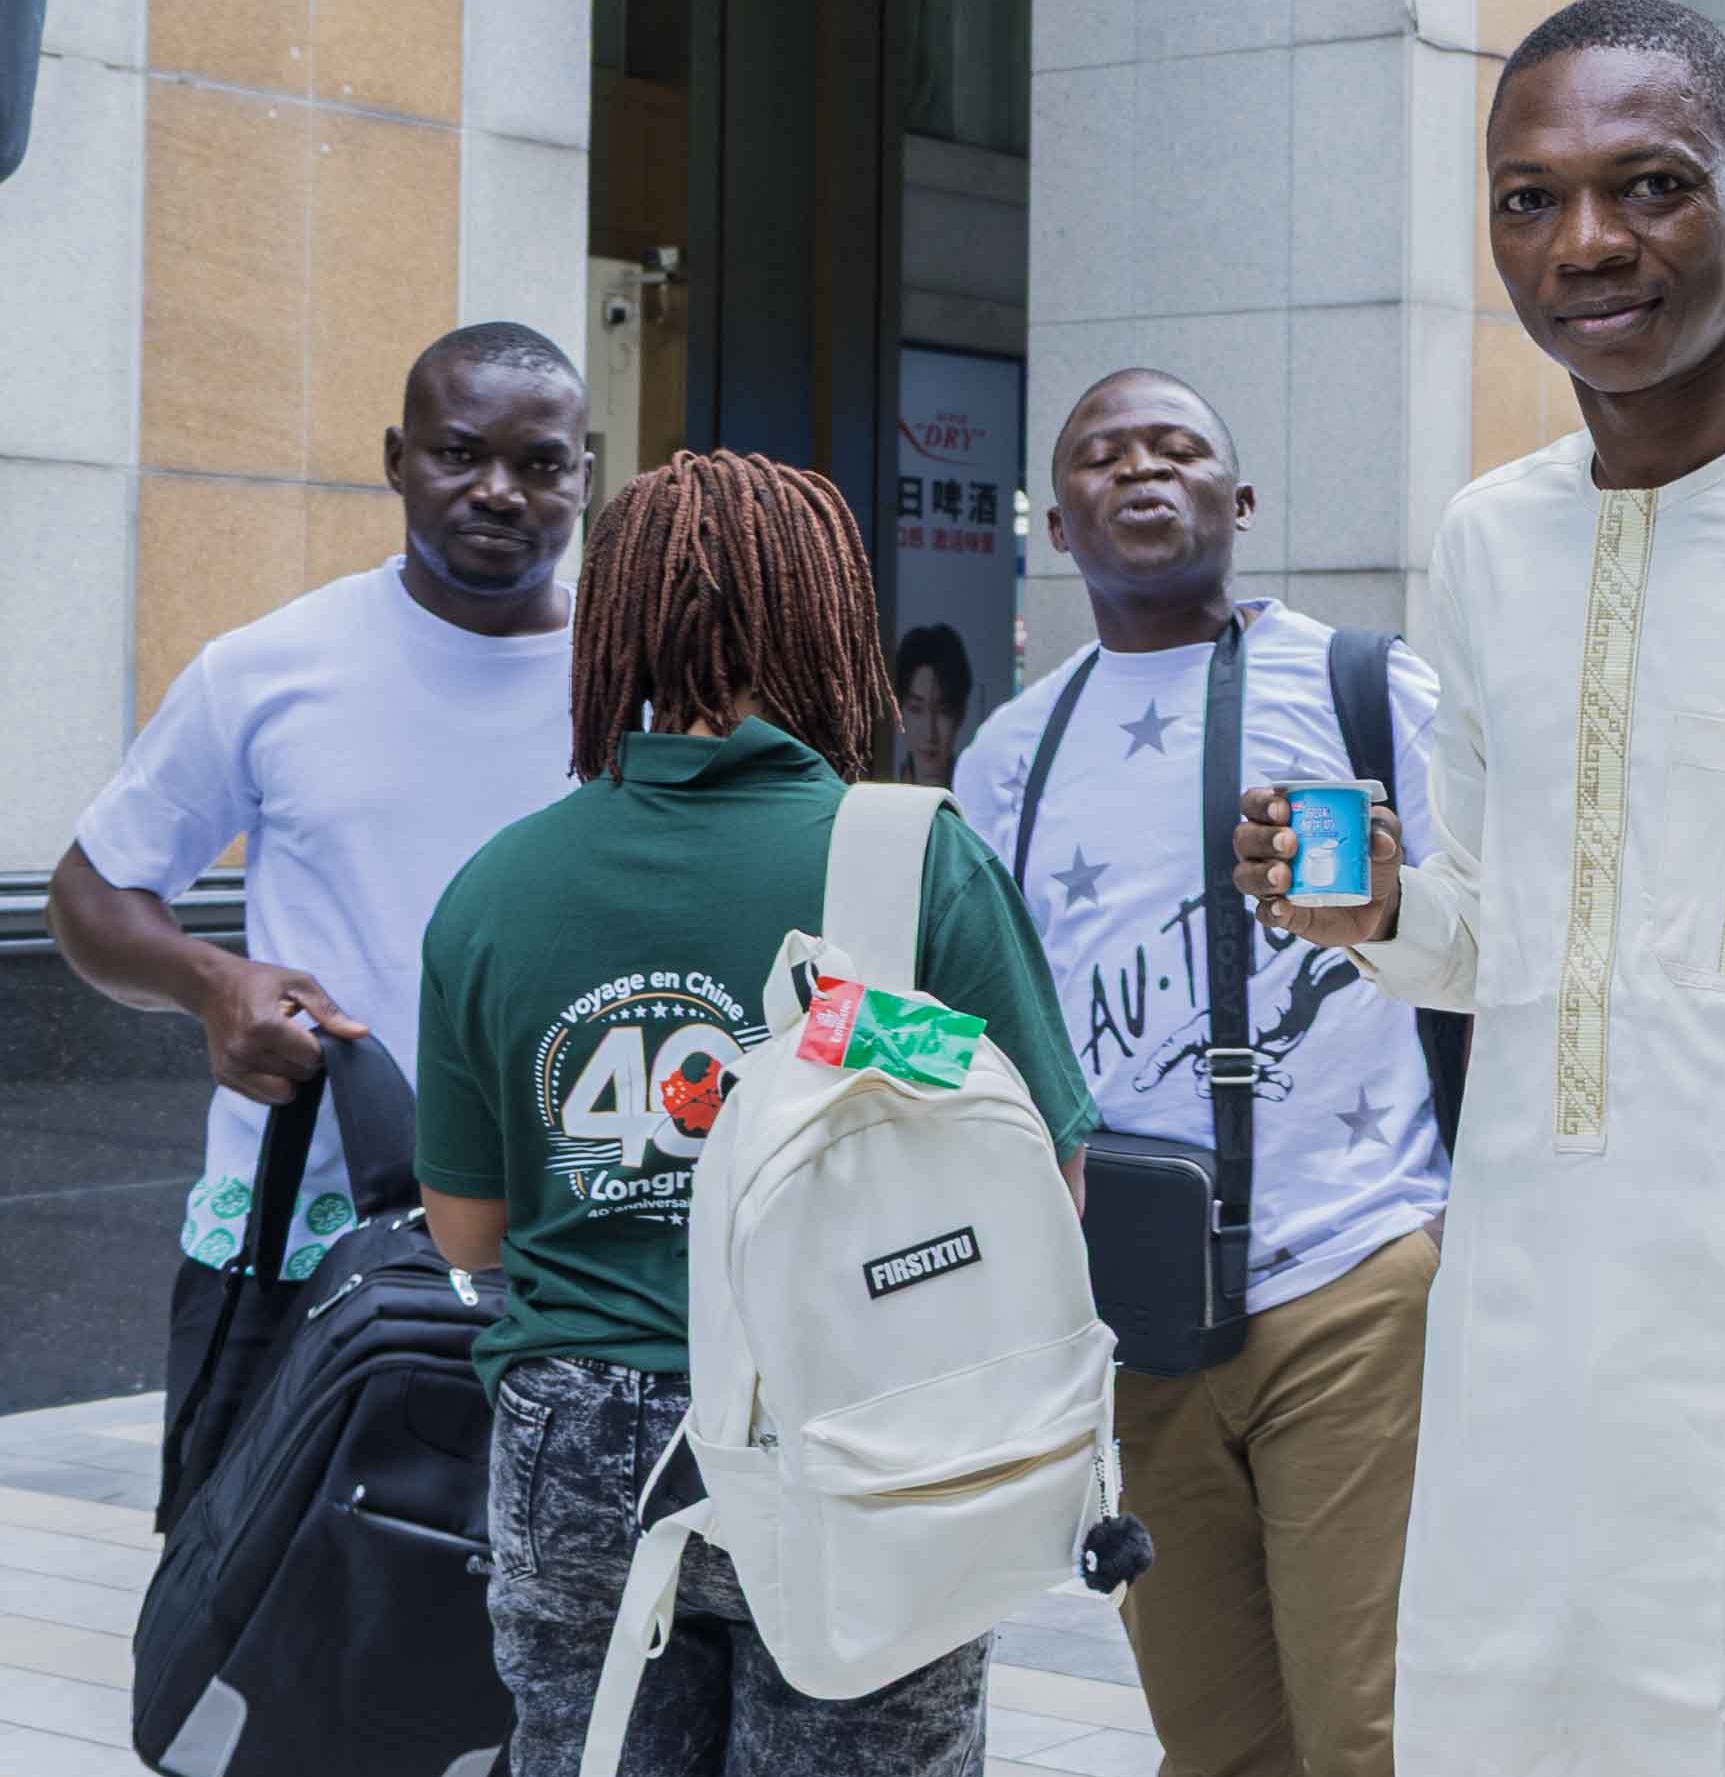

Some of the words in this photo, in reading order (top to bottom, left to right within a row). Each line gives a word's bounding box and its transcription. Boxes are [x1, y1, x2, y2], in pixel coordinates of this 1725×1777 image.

[650, 971, 680, 988] en
[686, 971, 744, 1021] Chine
[871, 1234, 973, 1290] FIRSTXTU
